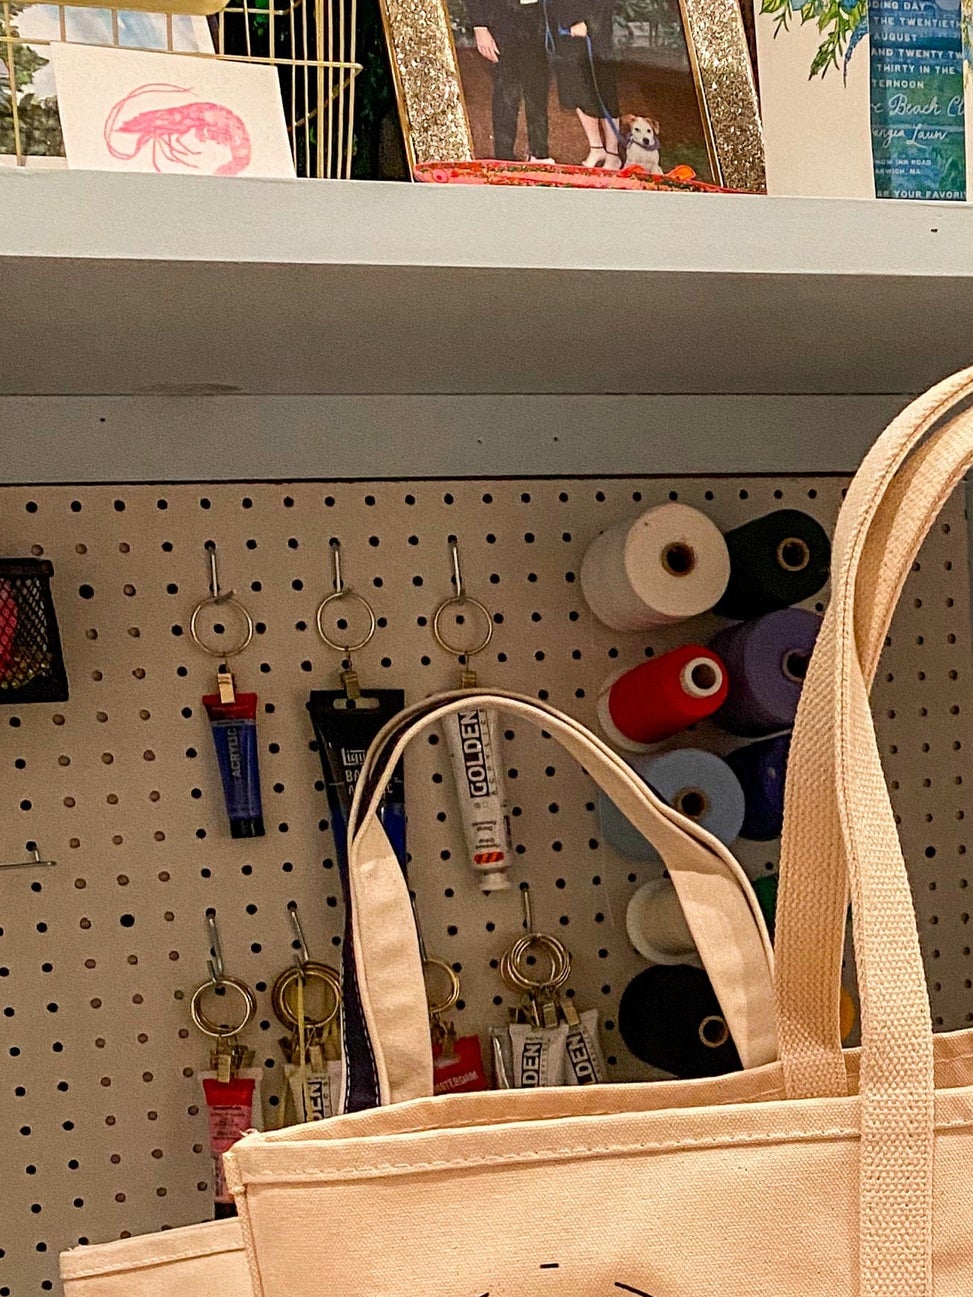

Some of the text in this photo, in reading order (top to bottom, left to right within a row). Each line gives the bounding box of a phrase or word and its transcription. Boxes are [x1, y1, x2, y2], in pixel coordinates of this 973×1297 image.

[903, 1, 925, 11] DAY
[874, 17, 895, 26] THE
[874, 32, 917, 42] AUGUST
[871, 48, 894, 57] AND
[877, 64, 956, 75] THIRTY IN THE
[894, 190, 922, 199] YOUR
[227, 727, 242, 778] ACRYLIC
[459, 709, 489, 797] GOLDEN
